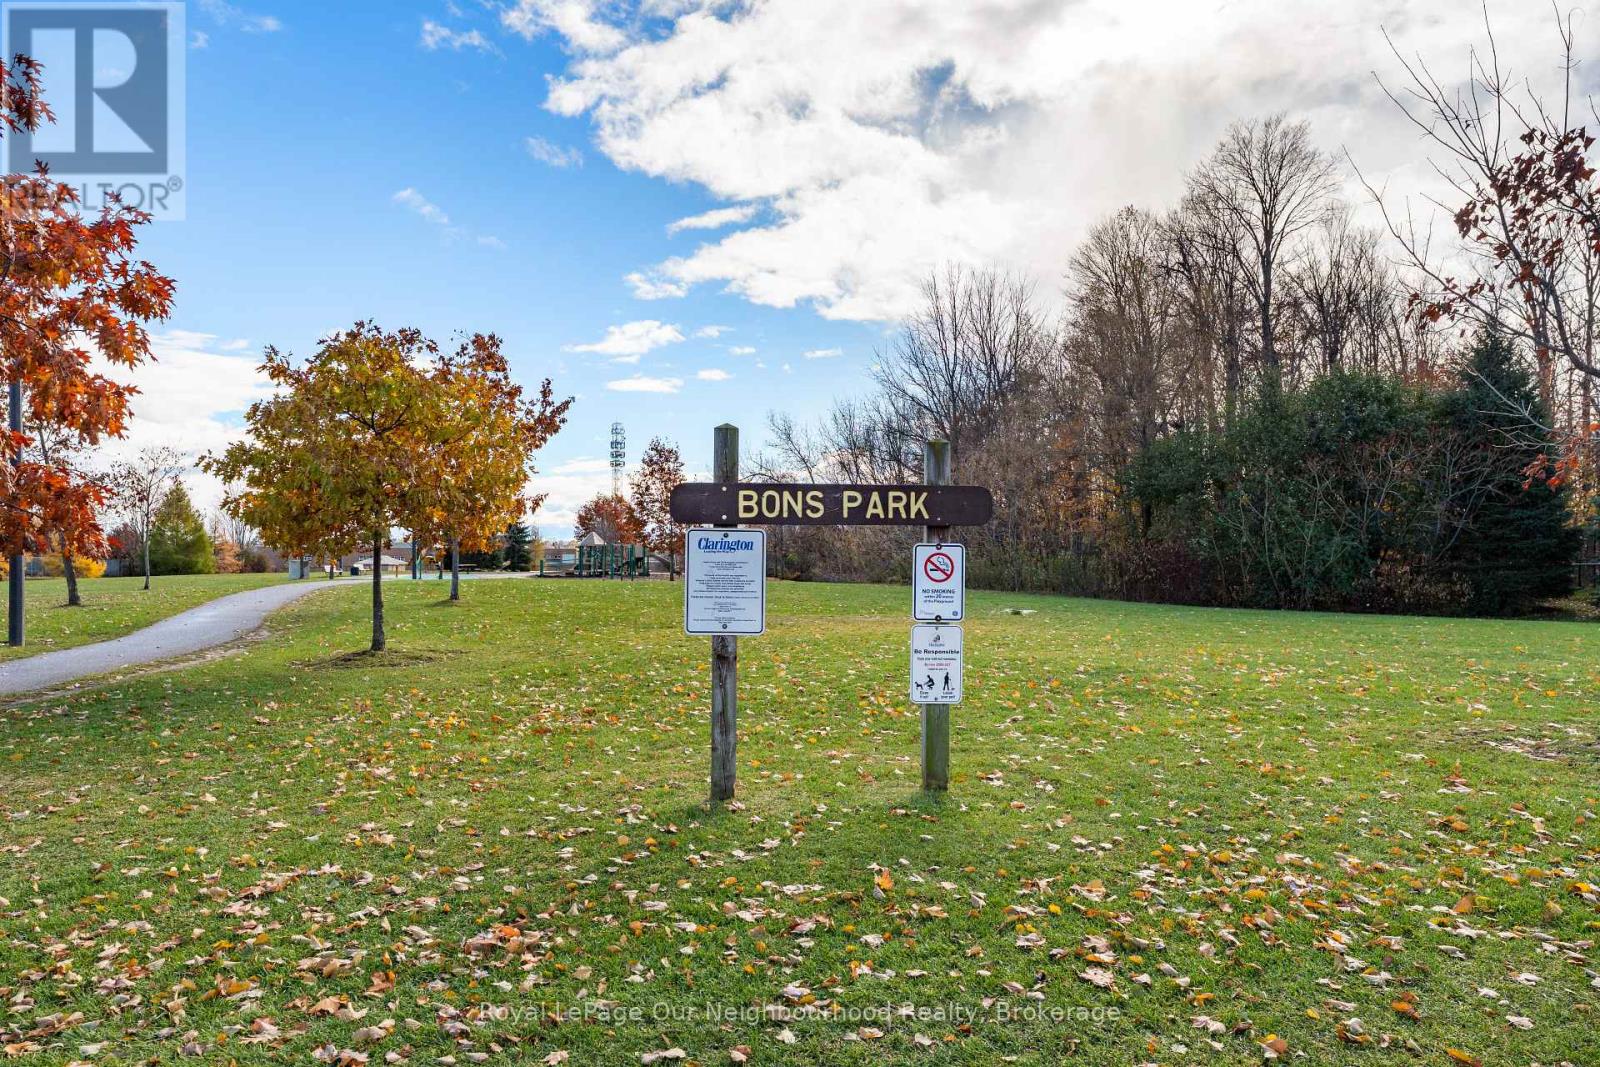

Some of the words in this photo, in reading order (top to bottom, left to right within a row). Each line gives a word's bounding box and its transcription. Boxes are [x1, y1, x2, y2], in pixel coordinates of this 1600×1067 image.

[738, 490, 824, 519] BONS
[842, 490, 930, 520] PARK
[698, 537, 754, 552] Clarington
